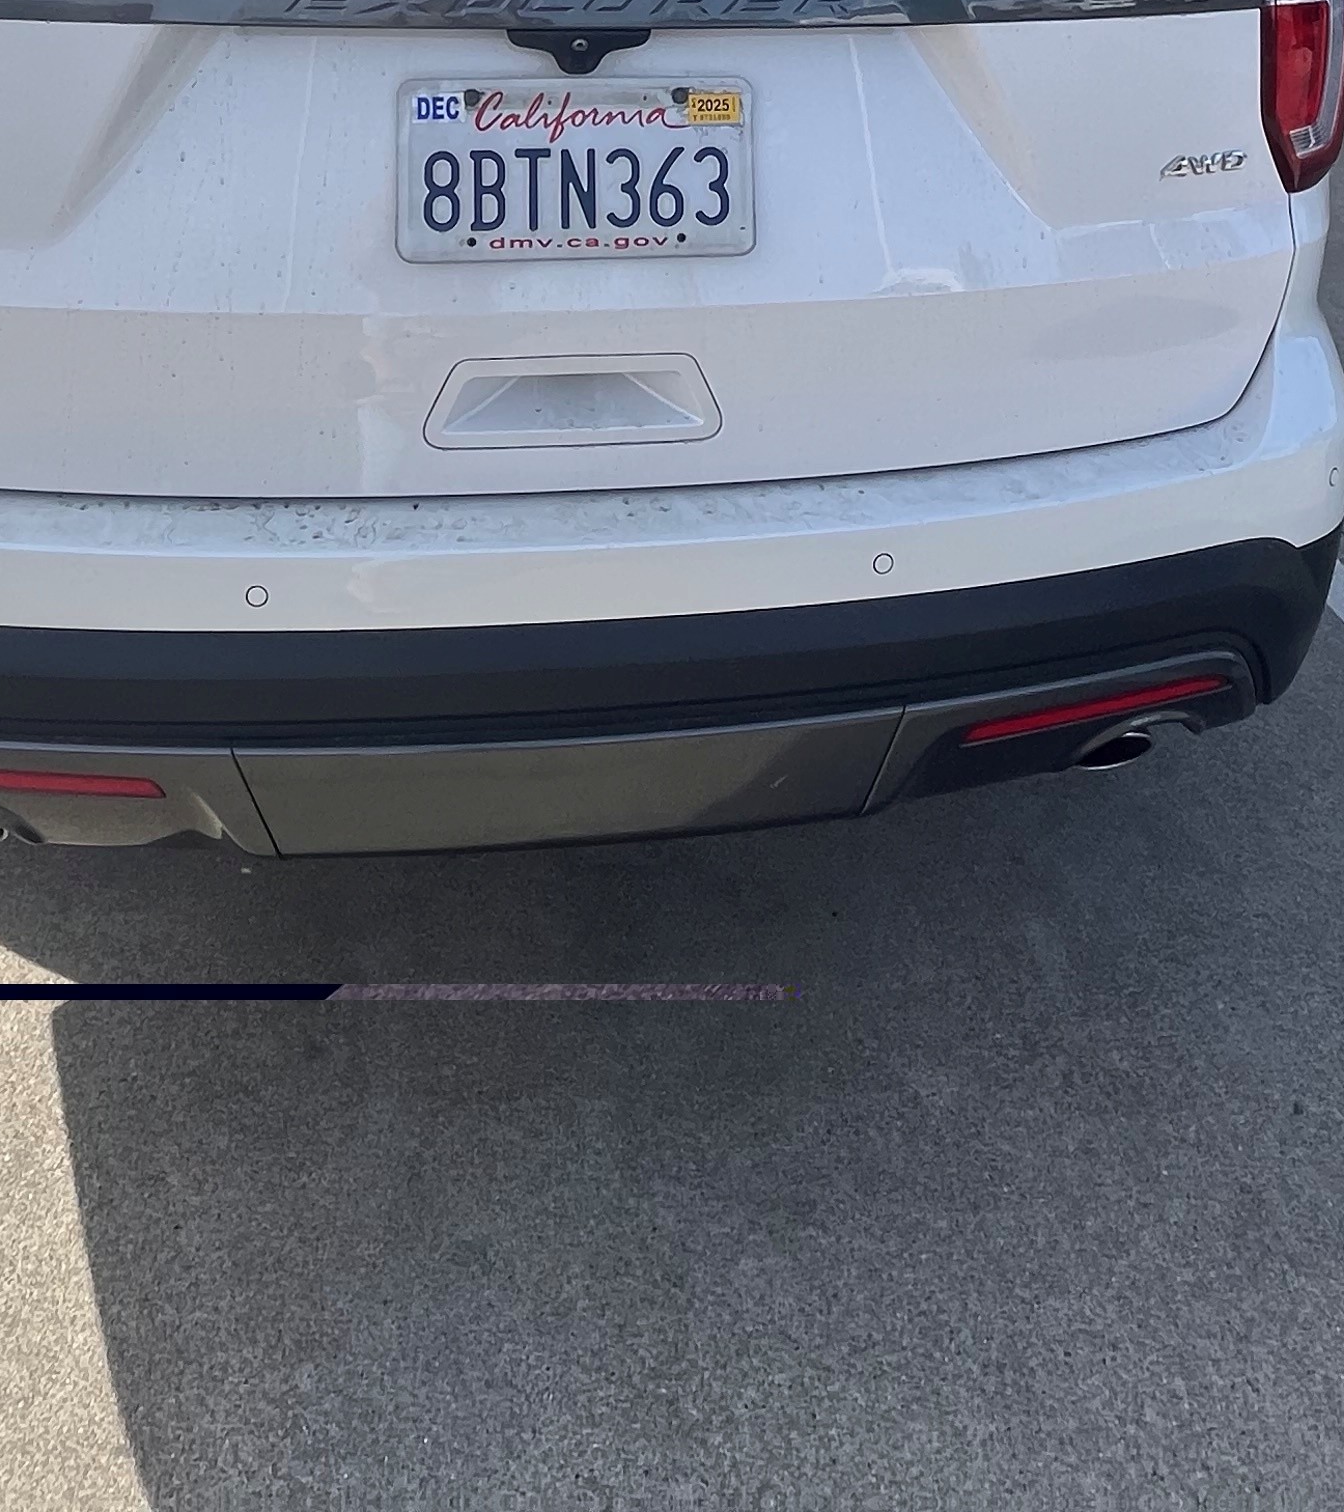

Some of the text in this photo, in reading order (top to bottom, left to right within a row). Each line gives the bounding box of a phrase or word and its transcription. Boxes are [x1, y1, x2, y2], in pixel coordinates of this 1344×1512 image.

[417, 96, 460, 120] DEC
[474, 91, 691, 144] California
[697, 98, 730, 112] 2025
[1159, 149, 1248, 181] 4WD
[423, 146, 731, 233] 8BTN363
[489, 234, 669, 250] dmv.ca.gov
